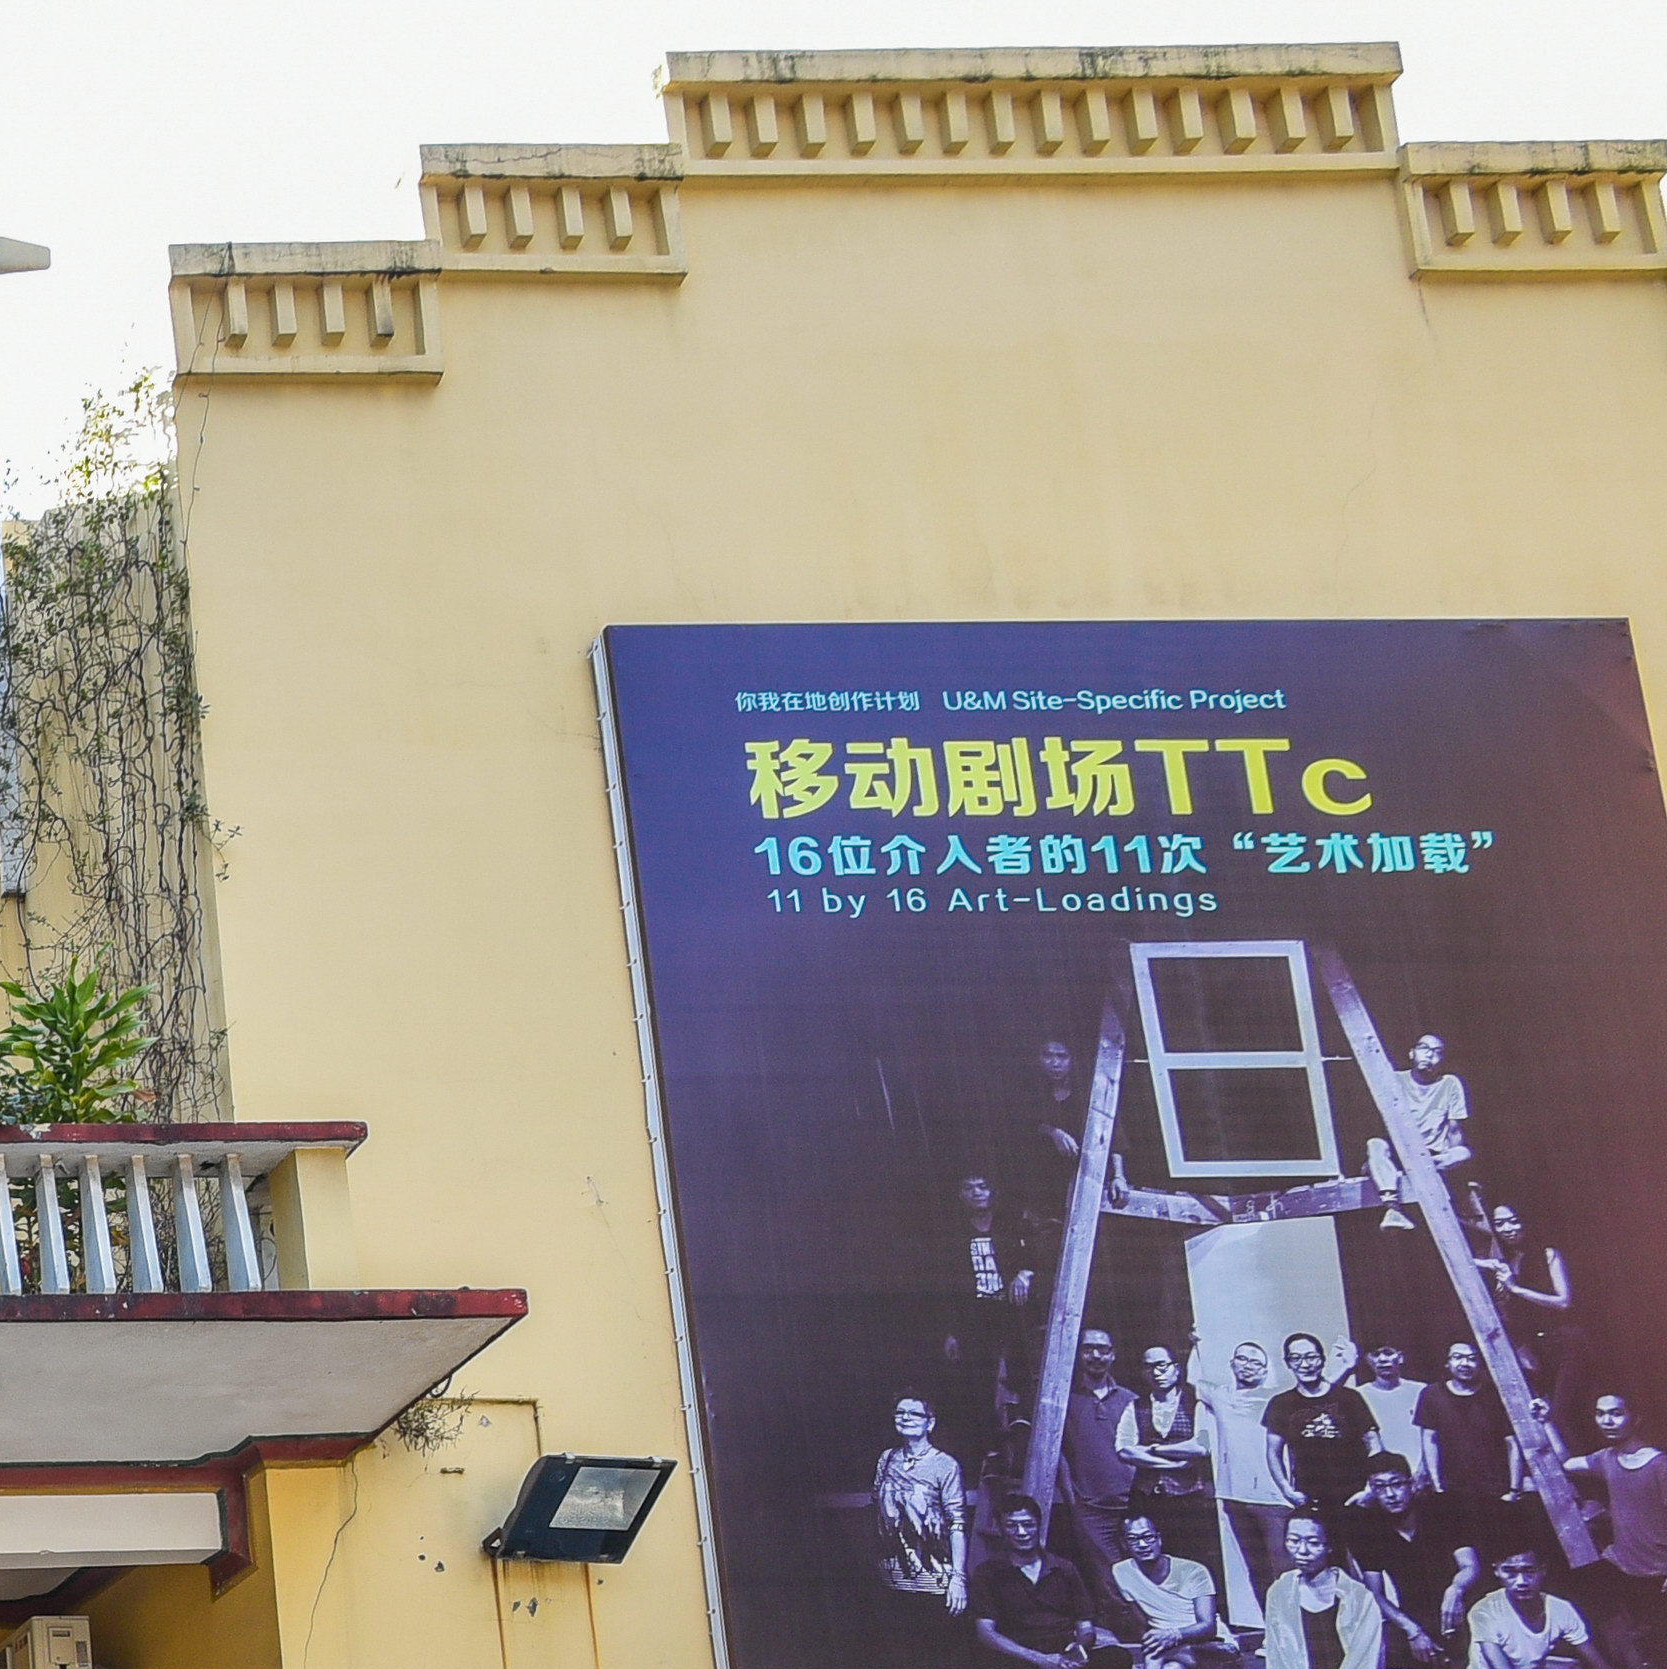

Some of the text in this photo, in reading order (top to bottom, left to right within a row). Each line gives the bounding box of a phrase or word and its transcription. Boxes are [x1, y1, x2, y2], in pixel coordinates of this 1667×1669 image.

[734, 688, 1287, 716] 你我在地创作计划 U&M Site-Specific Project
[766, 887, 1218, 919] 11 by 16 Art-Loadings
